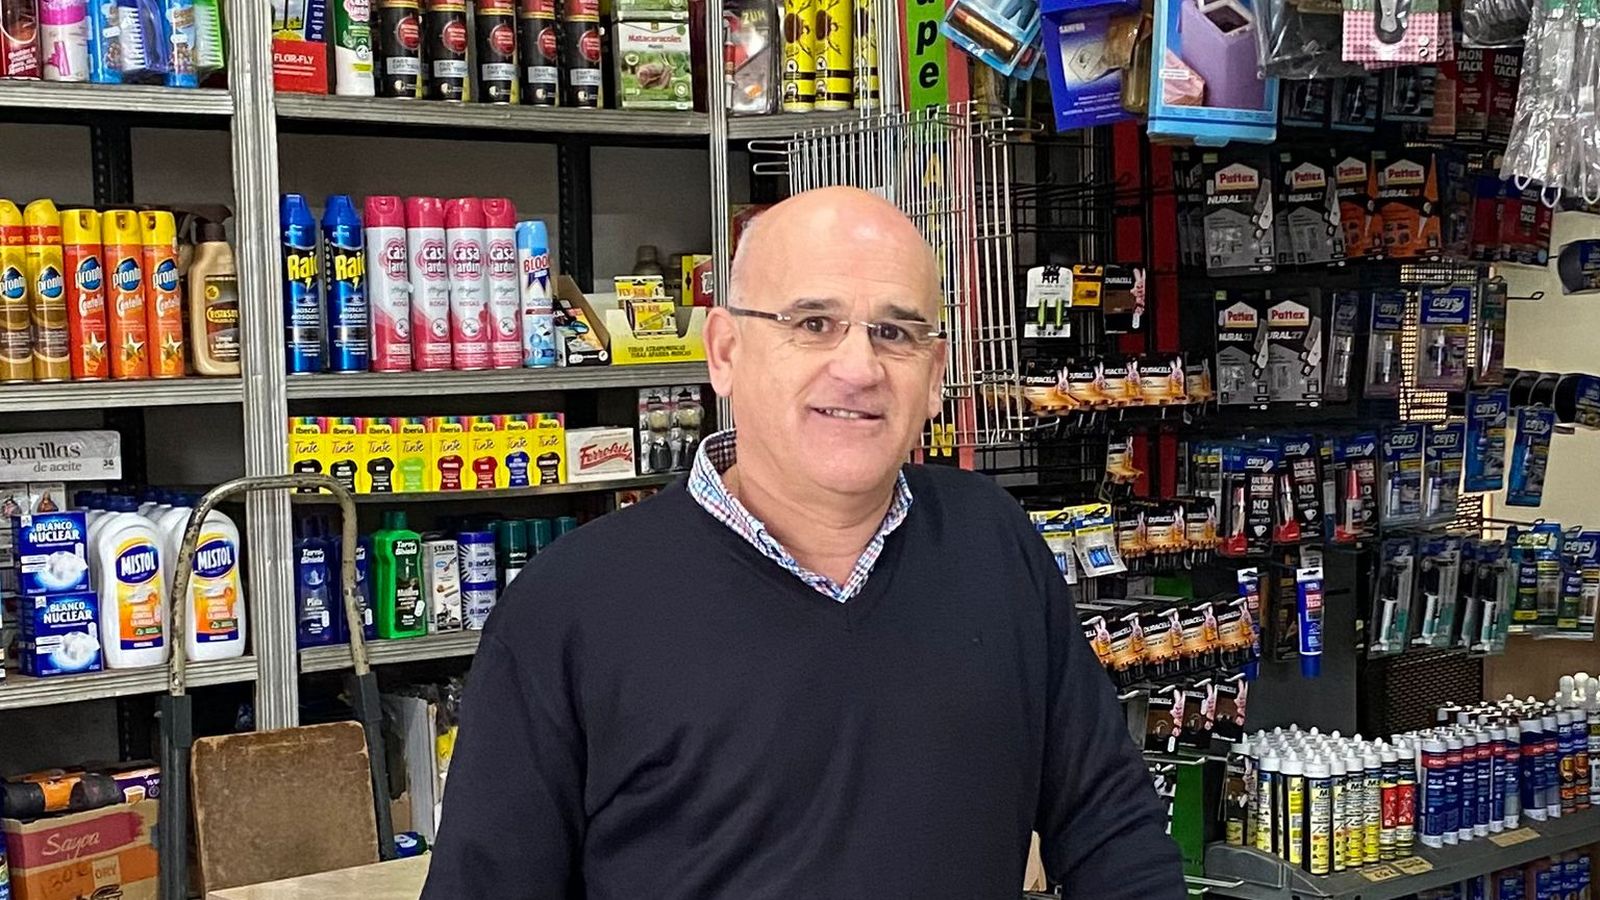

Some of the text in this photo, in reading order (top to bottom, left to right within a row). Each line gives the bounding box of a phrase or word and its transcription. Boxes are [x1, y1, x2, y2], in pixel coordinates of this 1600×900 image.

[1457, 50, 1483, 60] MON
[1494, 54, 1518, 65] MON
[1456, 61, 1484, 71] TACK
[1493, 65, 1518, 77] TACK
[1219, 173, 1255, 184] Pattex
[1294, 171, 1322, 182] Pattex
[1387, 168, 1420, 179] Pattex
[453, 246, 480, 261] casa
[490, 246, 515, 261] casa
[1227, 311, 1254, 321] Pattex
[1271, 310, 1305, 320] Pattex
[1392, 433, 1415, 445] ceys
[1433, 433, 1456, 445] ceys
[33, 461, 82, 472] de aceite
[1252, 499, 1269, 509] NO
[35, 521, 73, 532] BLANCO
[29, 529, 80, 543] NUCLEAR
[1516, 532, 1548, 545] ceys
[1563, 540, 1591, 553] ceys
[120, 552, 156, 577] MISTOL
[197, 546, 232, 572] MISTOL
[49, 601, 86, 612] BLANCO
[43, 610, 94, 624] NUCLEAR
